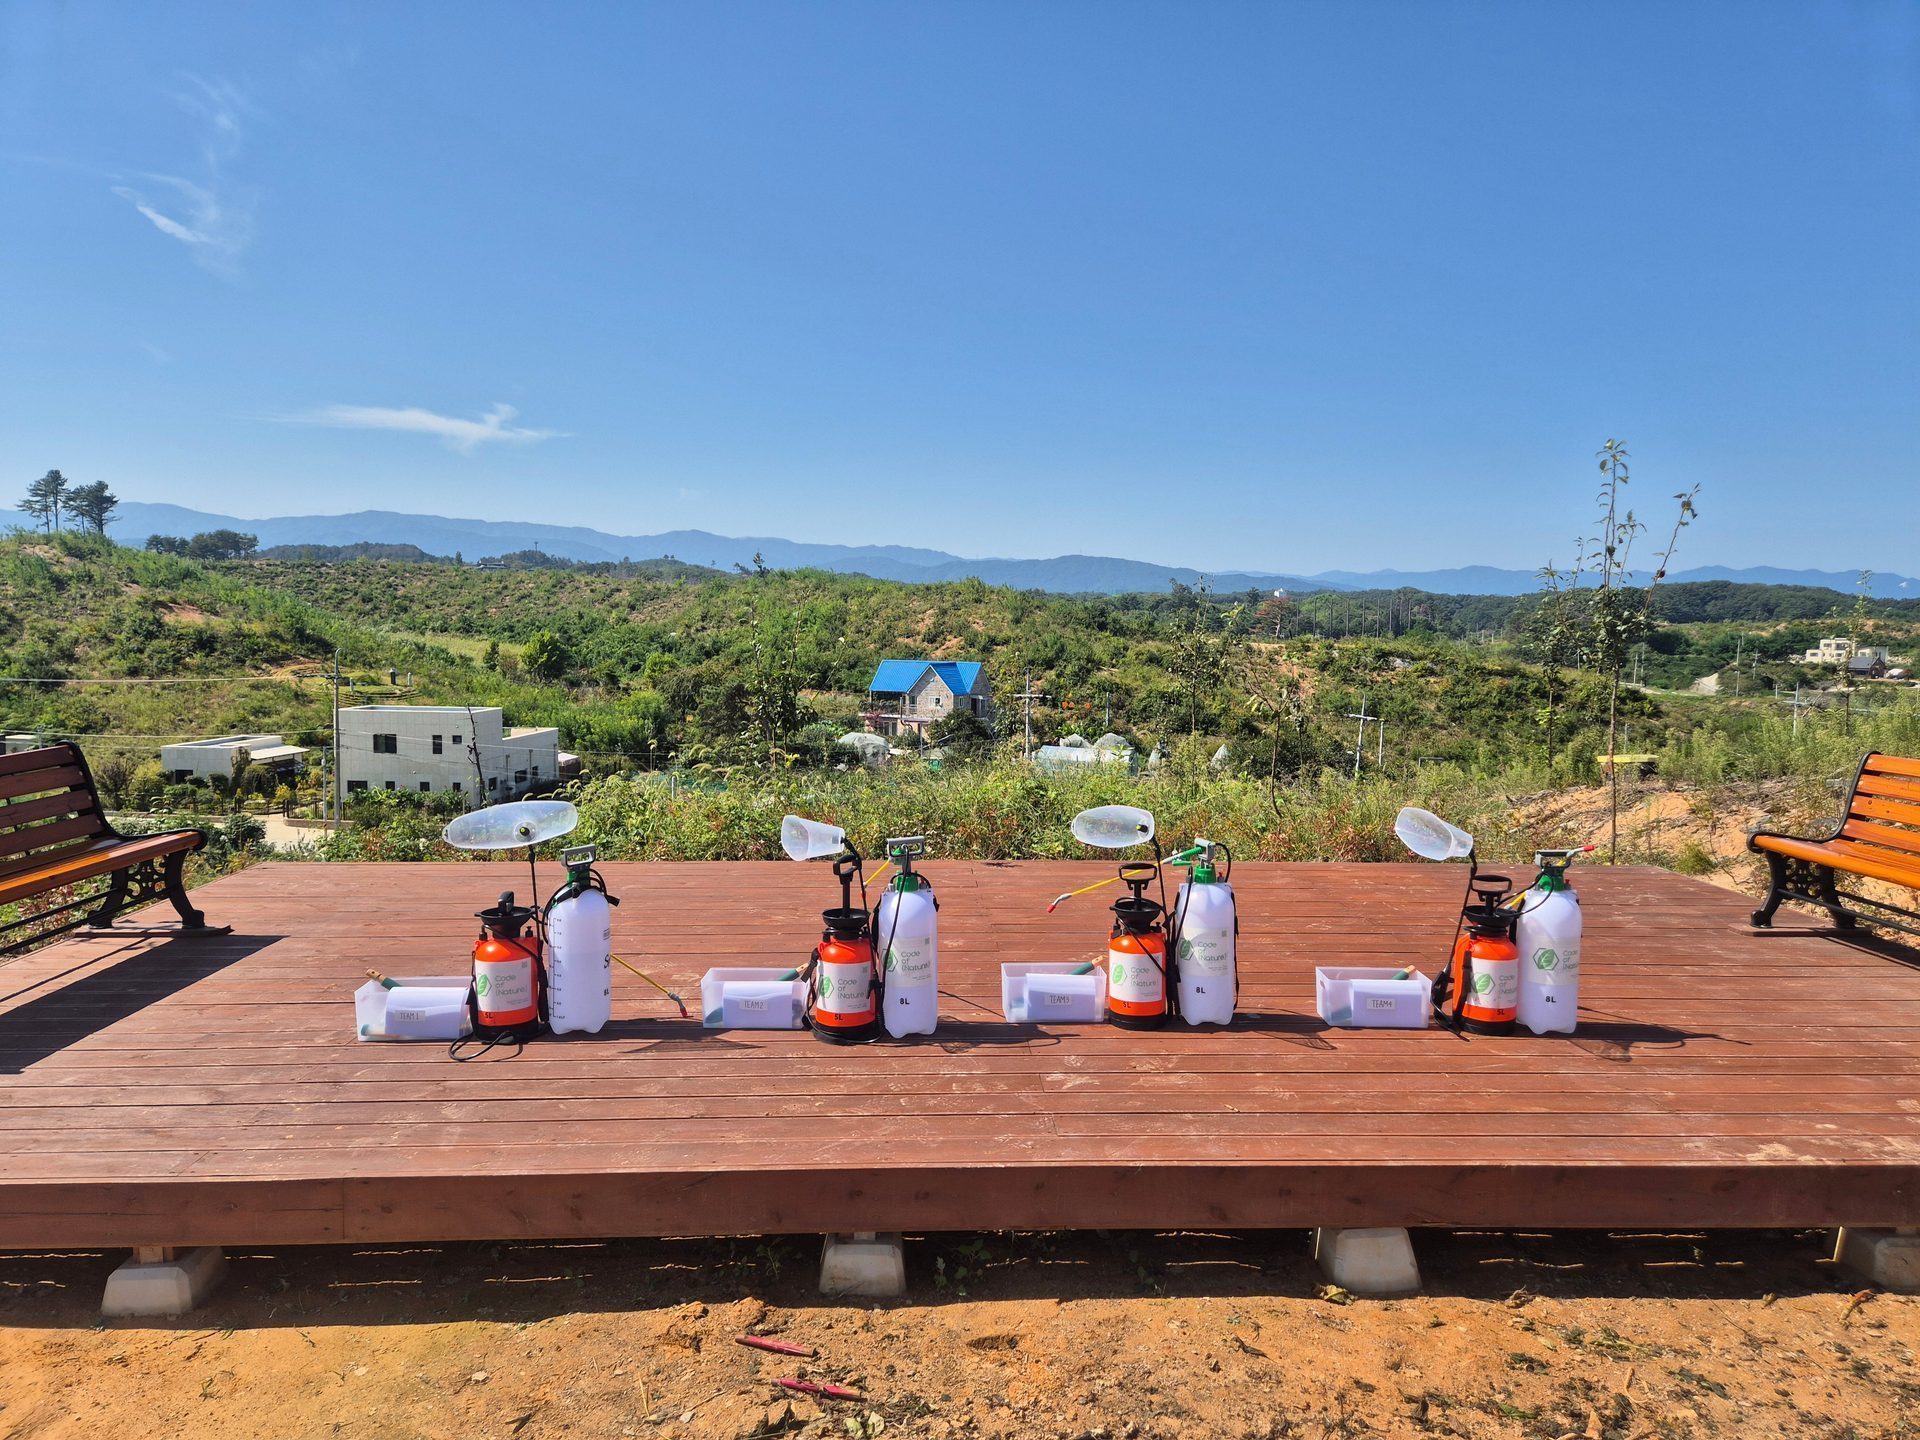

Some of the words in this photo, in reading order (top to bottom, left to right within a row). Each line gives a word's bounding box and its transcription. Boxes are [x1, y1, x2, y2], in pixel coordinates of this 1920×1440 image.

[901, 950, 921, 958] Code
[494, 974, 516, 982] Code
[837, 978, 858, 986] Code
[1196, 986, 1206, 994] 8L
[899, 997, 910, 1005] 8L
[1545, 995, 1556, 1003] 8L
